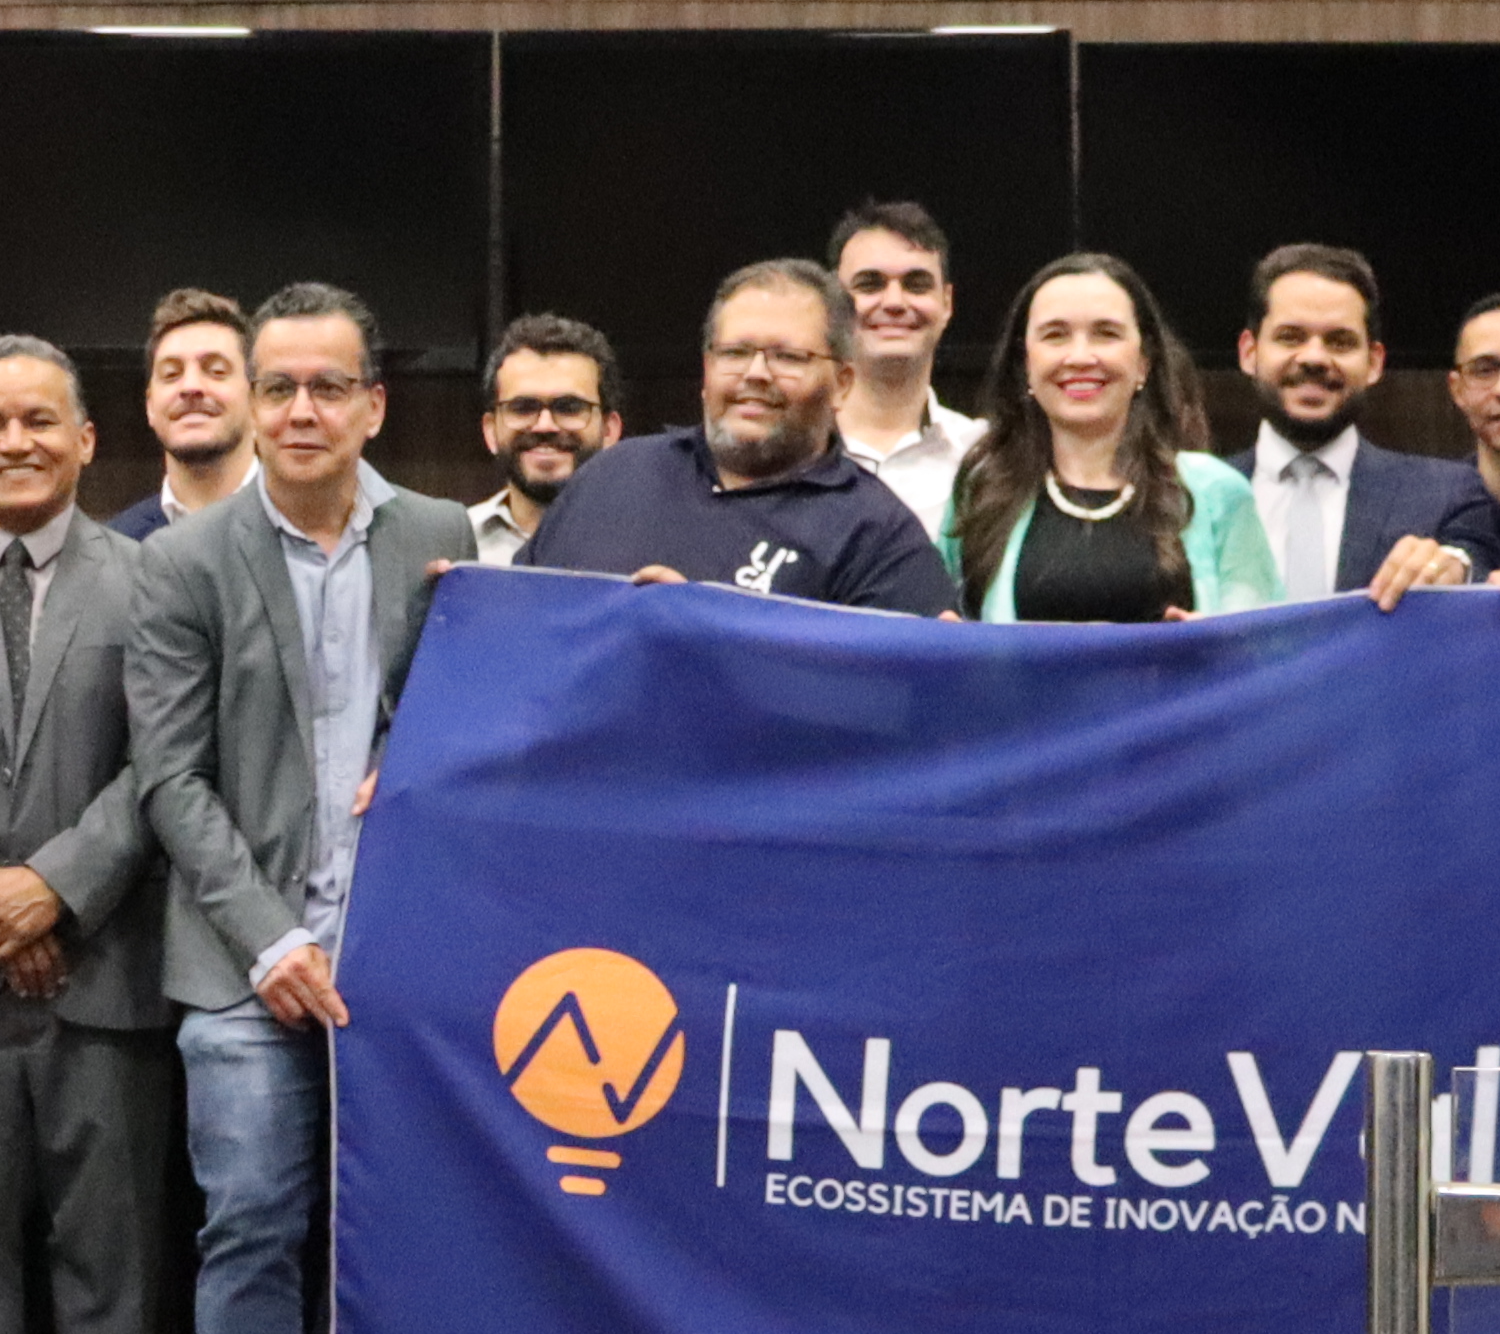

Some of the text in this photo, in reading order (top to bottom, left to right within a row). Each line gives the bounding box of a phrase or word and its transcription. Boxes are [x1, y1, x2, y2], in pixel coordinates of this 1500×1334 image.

[764, 1172, 1033, 1226] ECOSSISTEMA
[1043, 1194, 1093, 1229] DE
[1104, 1189, 1327, 1239] INOVAÇÃO
